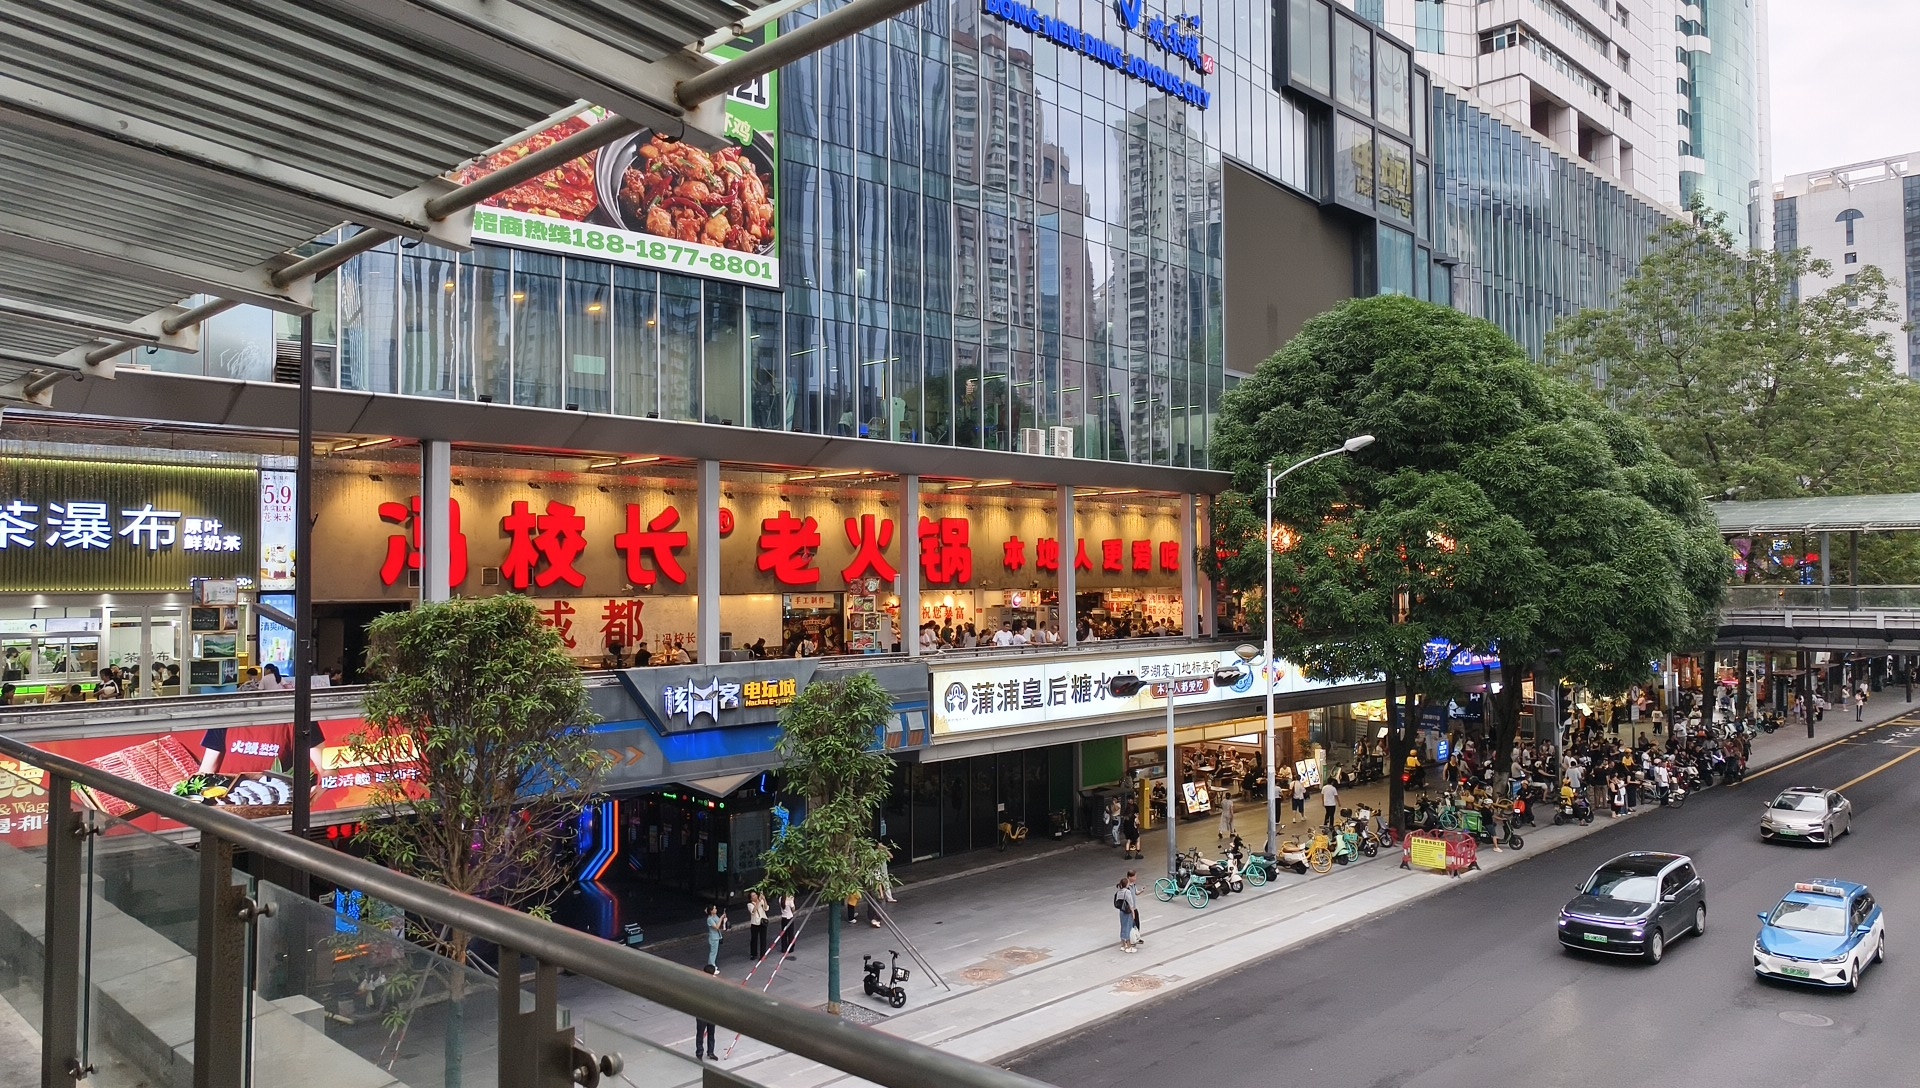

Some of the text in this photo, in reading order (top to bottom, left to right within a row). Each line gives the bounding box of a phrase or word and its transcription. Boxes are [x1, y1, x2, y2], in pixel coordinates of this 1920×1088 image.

[986, 0, 1211, 110] DONG MEN DING JOYOUS CITY
[474, 210, 773, 281] 招商热线188-1877-8801
[263, 485, 292, 505] 5.9
[0, 500, 182, 550] 茶瀑布
[183, 518, 223, 535] 原叶
[183, 534, 242, 552] 鲜奶茶
[378, 496, 1181, 590] 冯校长 老火锅 本地人更爱吃
[124, 651, 170, 664] 茶布
[743, 678, 797, 700] 电玩城
[971, 670, 1136, 715] 蒲浦皇后糖水
[12, 801, 49, 815] Wag
